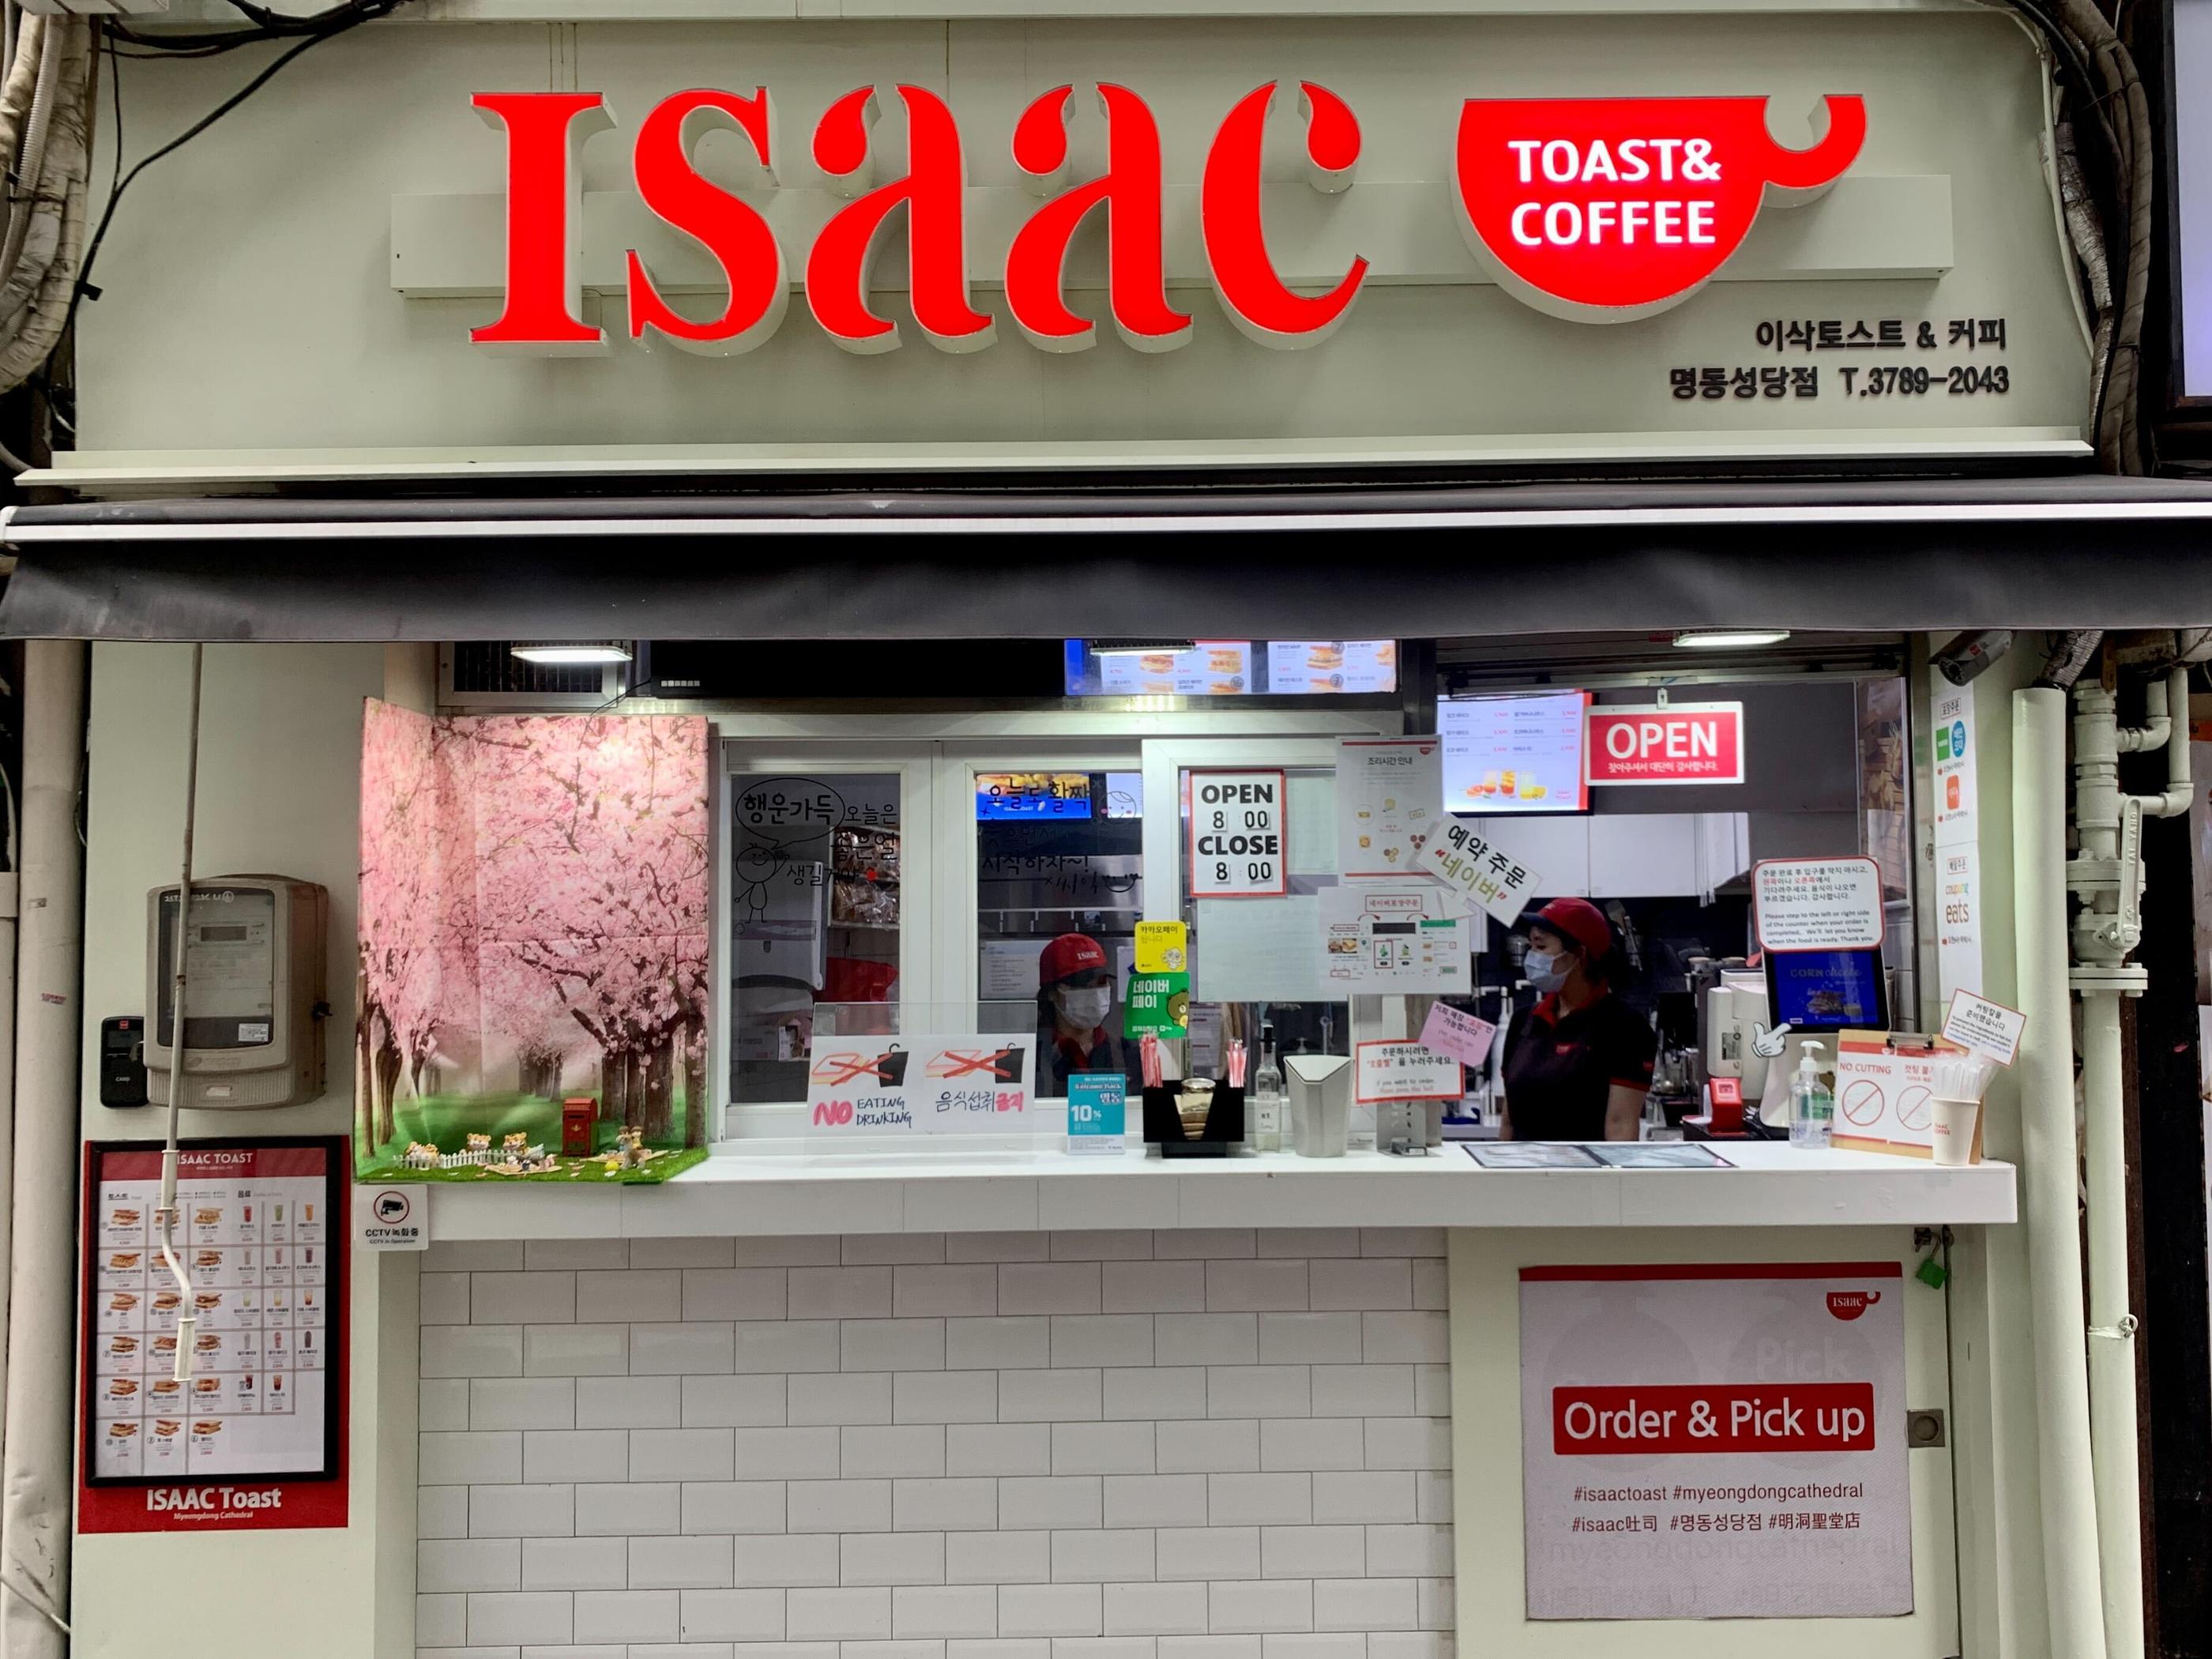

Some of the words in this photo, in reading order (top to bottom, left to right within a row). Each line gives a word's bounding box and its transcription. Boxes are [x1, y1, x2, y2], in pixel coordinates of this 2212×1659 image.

[1510, 200, 1716, 246] COFFEE
[1755, 319, 1906, 350] 이삭토스트
[1917, 321, 1937, 348] &
[1948, 318, 2007, 350] 커피
[1669, 367, 1819, 397] 명동성당점
[1839, 366, 2011, 397] T.3789-2043
[1605, 721, 1718, 759] OPEN
[1367, 757, 1397, 766] 조리시간
[1398, 756, 1413, 766] 안내
[986, 777, 1046, 811] 오늘도
[1201, 784, 1273, 804] OPEN
[845, 803, 897, 826] 오늘은
[1198, 835, 1278, 856] CLOSE
[1447, 825, 1488, 862] 예약
[1488, 852, 1527, 890] 주문
[1946, 900, 1969, 924] eats
[1132, 980, 1170, 994] 네이버
[1132, 994, 1157, 1009] 페이
[1839, 1062, 1853, 1071] NO
[1855, 1063, 1891, 1074] CUTTING
[812, 1100, 853, 1127] NO
[856, 1097, 905, 1110] EATING
[856, 1112, 912, 1129] DRINKING
[214, 1153, 254, 1164] TOAST
[365, 1228, 391, 1237] CCTV
[1564, 1399, 1676, 1441] Order
[1687, 1400, 1719, 1438] &
[1730, 1398, 1805, 1437] Pick
[1817, 1408, 1865, 1443] up
[147, 1487, 216, 1511] ISAAC
[218, 1487, 282, 1510] Toast
[1573, 1485, 1668, 1502] #isaactoast
[1672, 1483, 1864, 1503] #myeongdongcathedral
[173, 1512, 220, 1521] Myeongdong
[220, 1510, 254, 1519] Cathedral
[1571, 1515, 1658, 1533] #isaac吐司
[1669, 1514, 1762, 1532] #명동성당점
[1767, 1512, 1860, 1531] #明洞聖堂店
